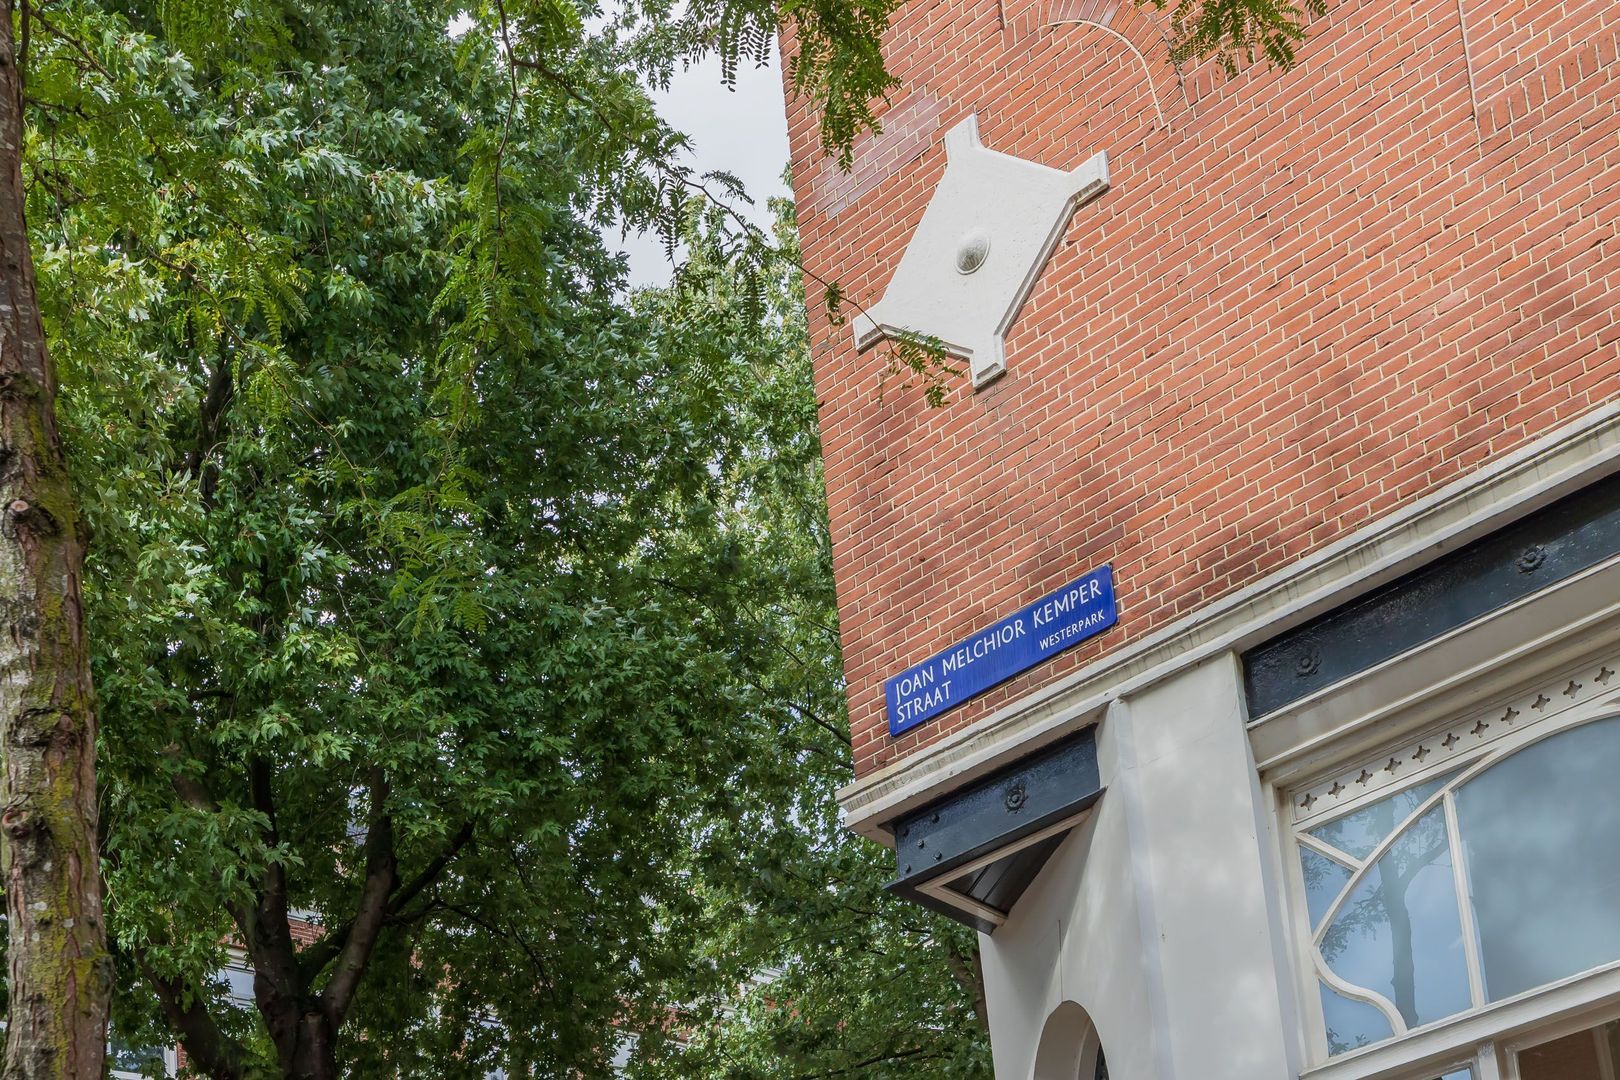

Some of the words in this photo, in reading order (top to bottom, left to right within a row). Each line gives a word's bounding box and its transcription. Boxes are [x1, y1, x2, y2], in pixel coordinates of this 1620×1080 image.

[895, 665, 934, 705] JOAN
[942, 619, 1026, 676] MELCHIOR
[1033, 579, 1102, 629] KEMPER
[1039, 609, 1105, 651] WESTERPARK
[897, 680, 952, 724] STRAAT
